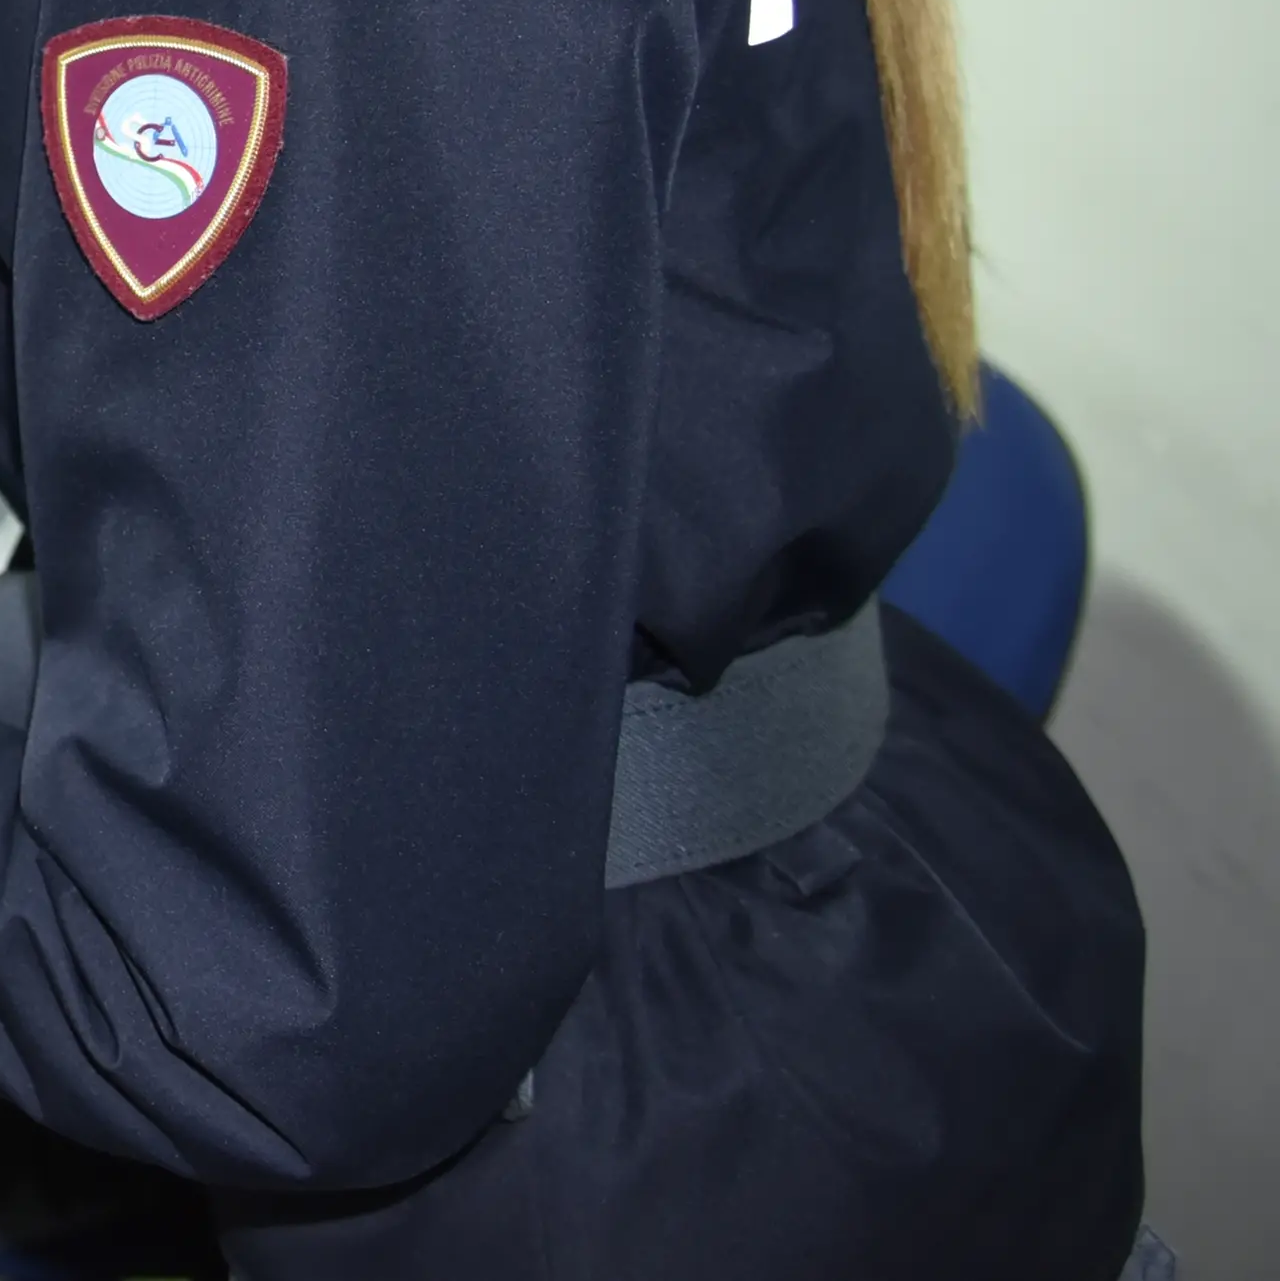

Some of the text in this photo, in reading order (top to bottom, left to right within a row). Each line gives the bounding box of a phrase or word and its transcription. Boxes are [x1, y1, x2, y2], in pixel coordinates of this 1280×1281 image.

[83, 53, 235, 127] DIVISIONE POLIZIA ANTICRIMINE
